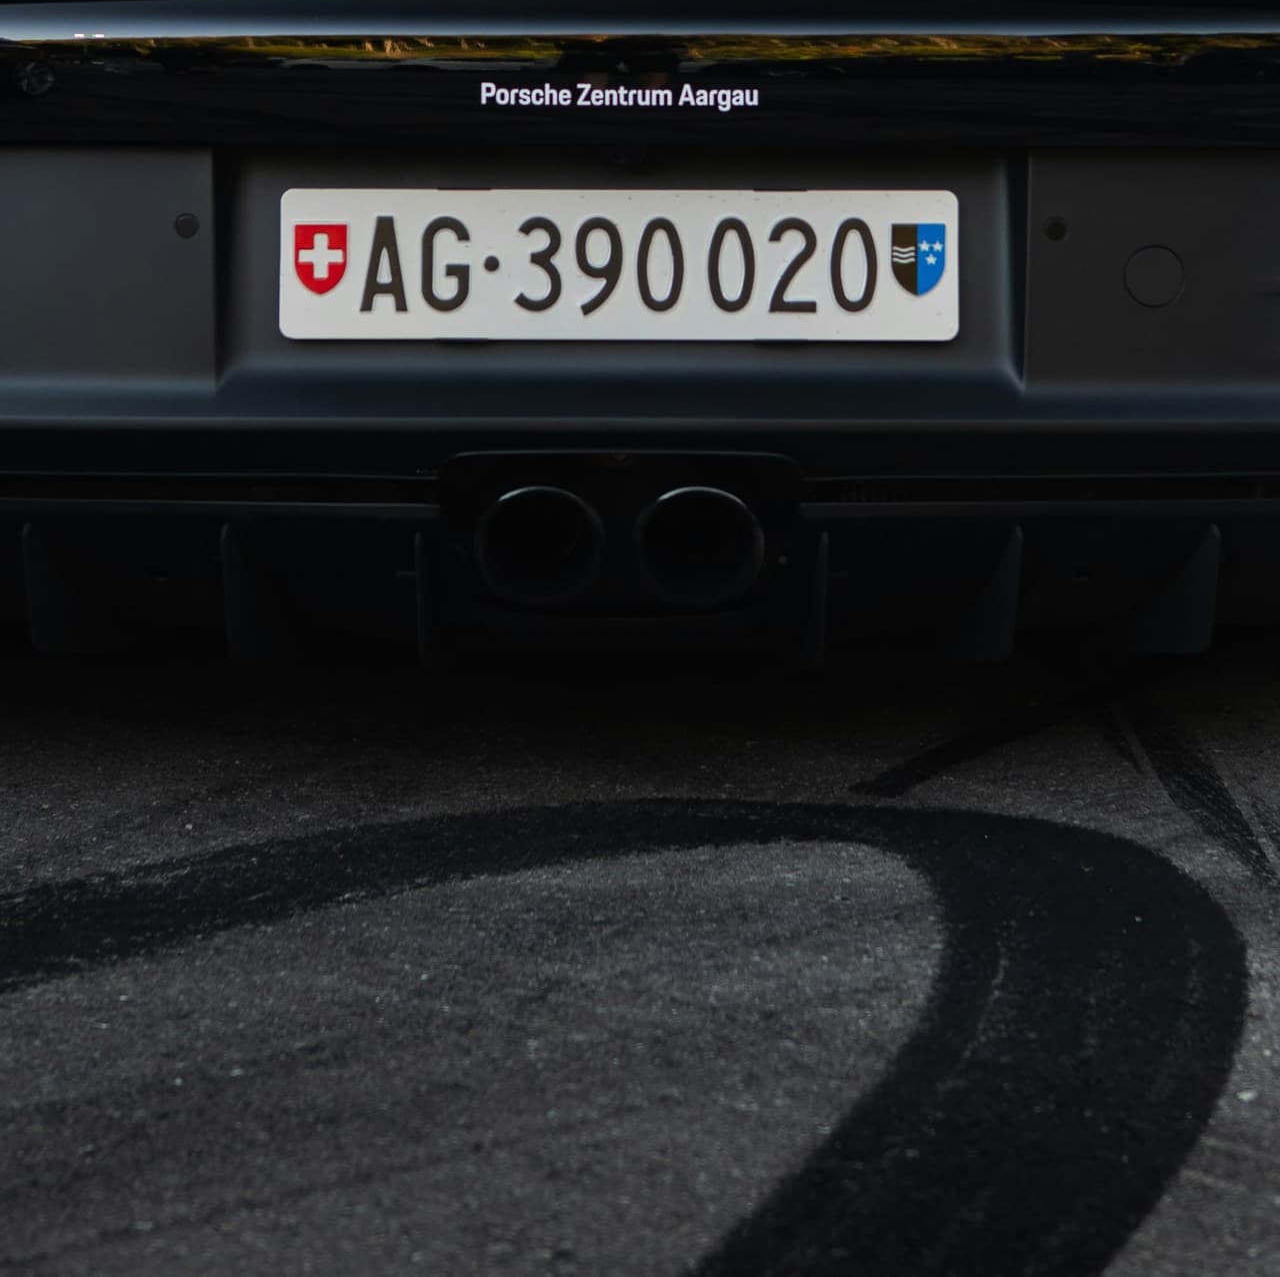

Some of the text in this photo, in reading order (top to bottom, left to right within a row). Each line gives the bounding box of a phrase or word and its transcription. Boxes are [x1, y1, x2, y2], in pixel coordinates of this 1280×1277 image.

[480, 82, 759, 112] Porsche Zentrum Aargau
